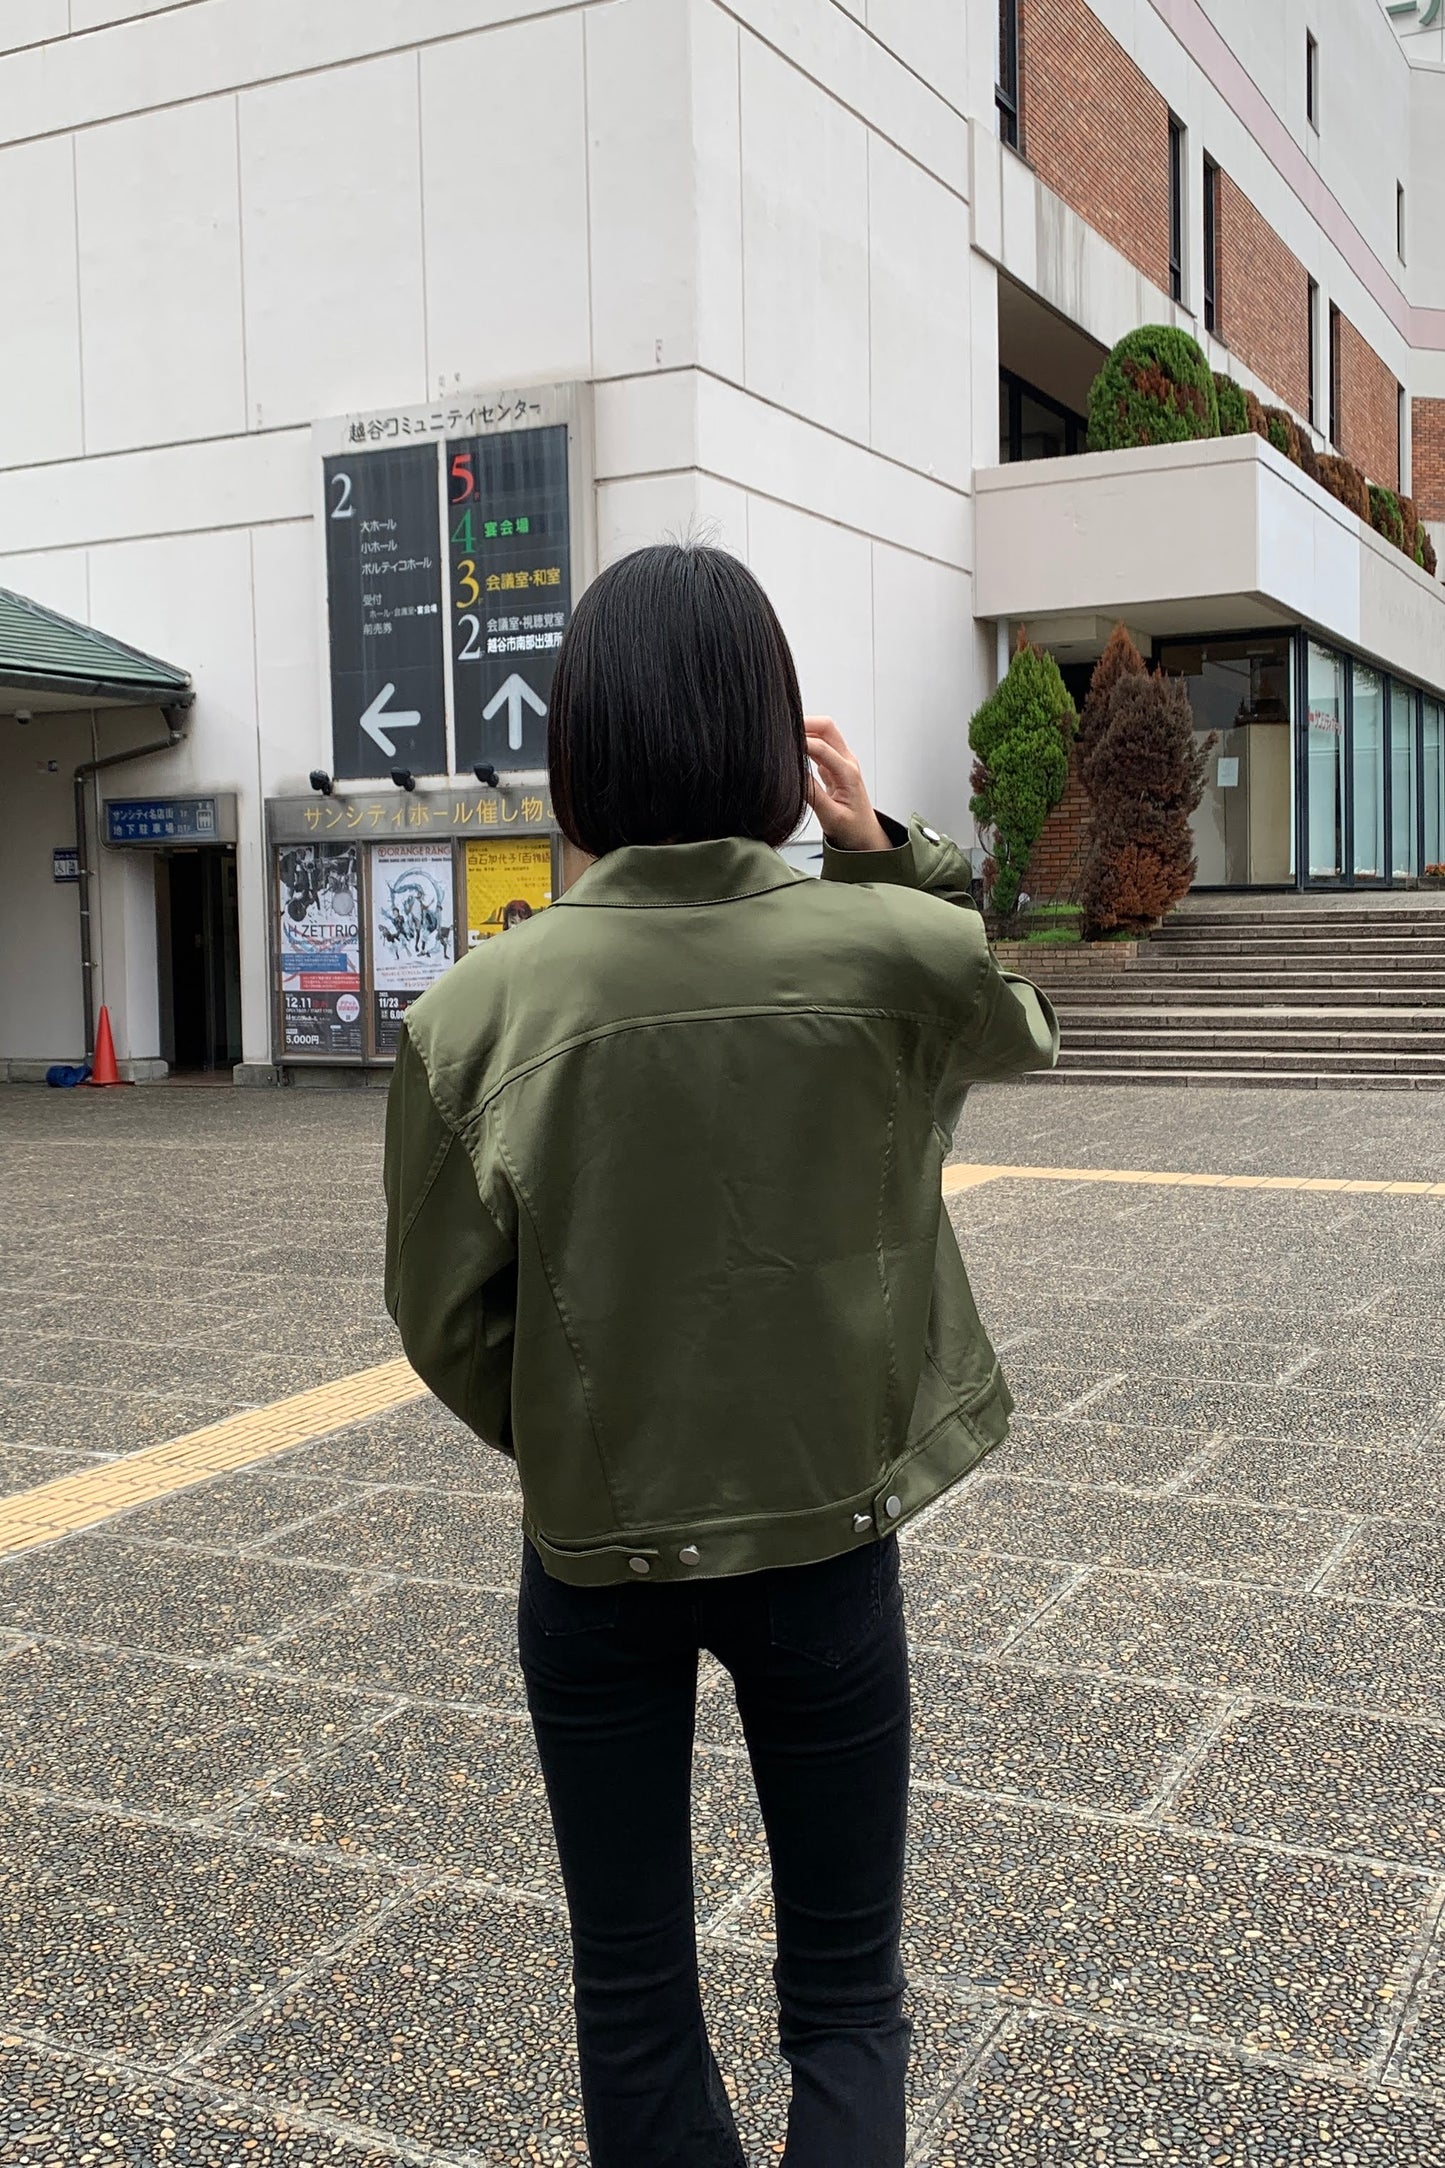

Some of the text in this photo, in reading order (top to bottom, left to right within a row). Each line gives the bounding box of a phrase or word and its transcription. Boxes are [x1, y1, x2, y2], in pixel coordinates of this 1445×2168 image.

[348, 399, 540, 443] 越谷コミュニティセンター
[360, 518, 398, 533] 大ホール
[451, 508, 530, 554] 4 宴会場
[361, 539, 398, 554] 小ホール
[362, 593, 382, 607] 受付
[363, 622, 393, 635] 前売券
[487, 631, 563, 654] 越谷市南部出張所
[113, 822, 175, 837] 地下駐車場
[387, 846, 424, 857] ORANGE
[286, 997, 312, 1008] 12.11
[379, 997, 399, 1008] 11/23
[286, 1035, 320, 1045] 5,000円
